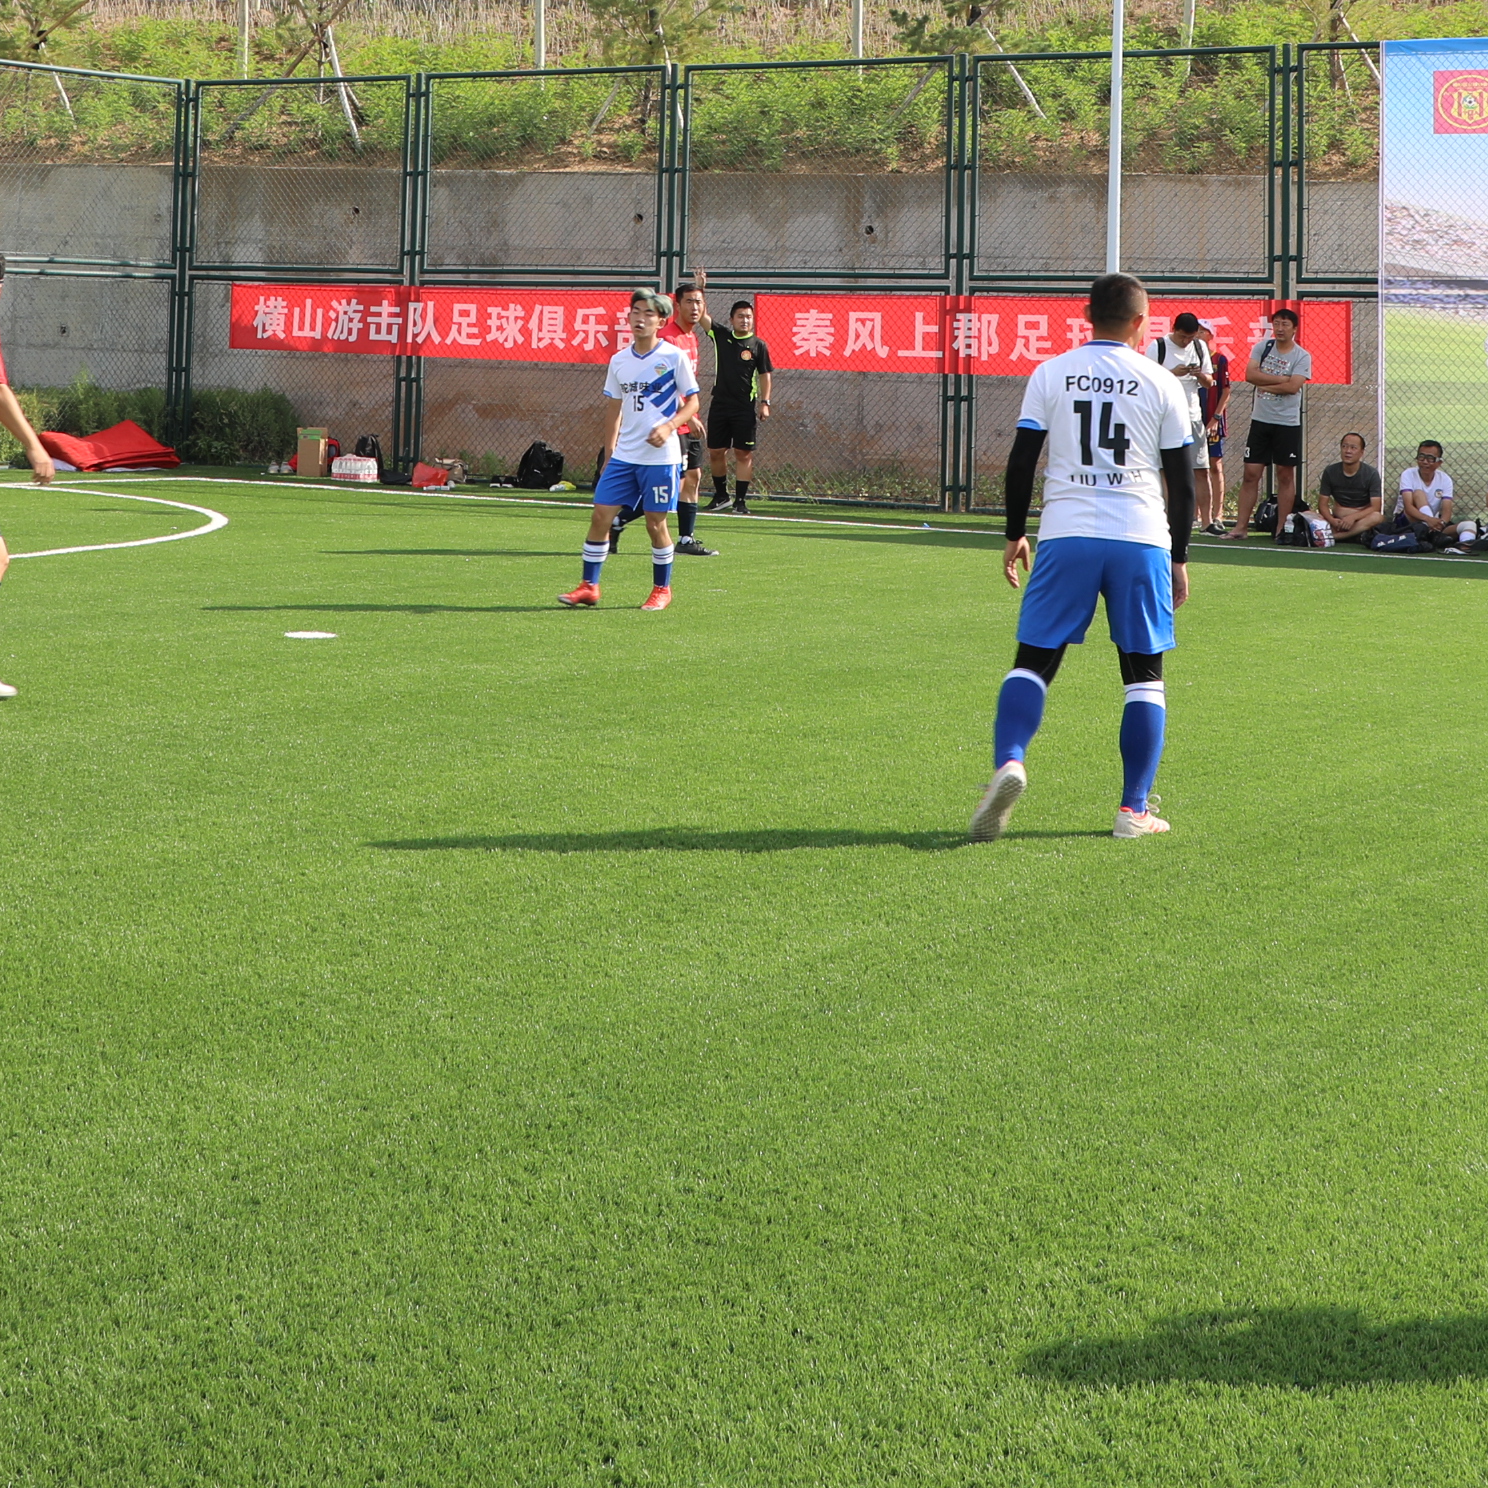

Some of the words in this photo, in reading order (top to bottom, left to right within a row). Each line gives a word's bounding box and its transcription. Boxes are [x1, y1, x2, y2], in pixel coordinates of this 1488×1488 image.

[1065, 375, 1139, 397] FC0912
[633, 395, 645, 412] 15
[1073, 399, 1130, 467] 14
[652, 485, 669, 504] 15
